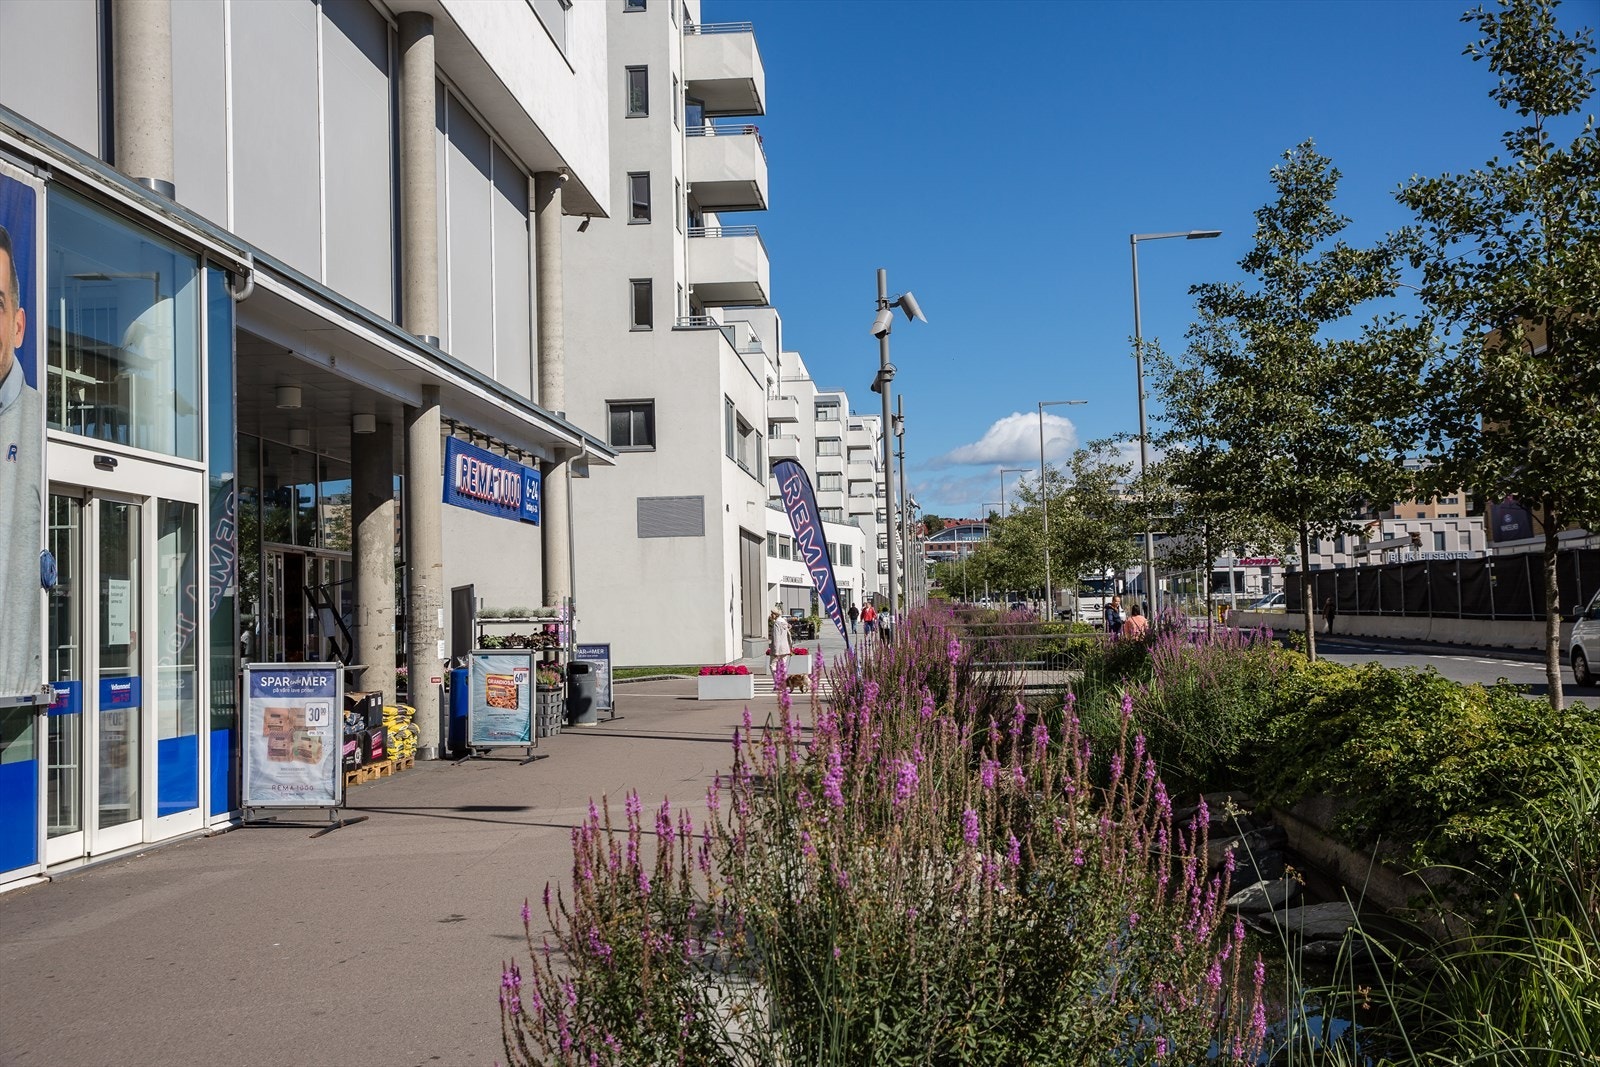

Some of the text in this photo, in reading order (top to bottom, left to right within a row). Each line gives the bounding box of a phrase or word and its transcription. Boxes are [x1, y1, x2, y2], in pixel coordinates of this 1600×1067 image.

[7, 442, 18, 463] R
[457, 454, 522, 507] REMA 1000
[783, 474, 829, 594] REMA
[1390, 551, 1469, 562] BUKBILSENTER
[260, 676, 290, 687] SPAR
[301, 676, 327, 687] MER
[308, 707, 320, 722] 30
